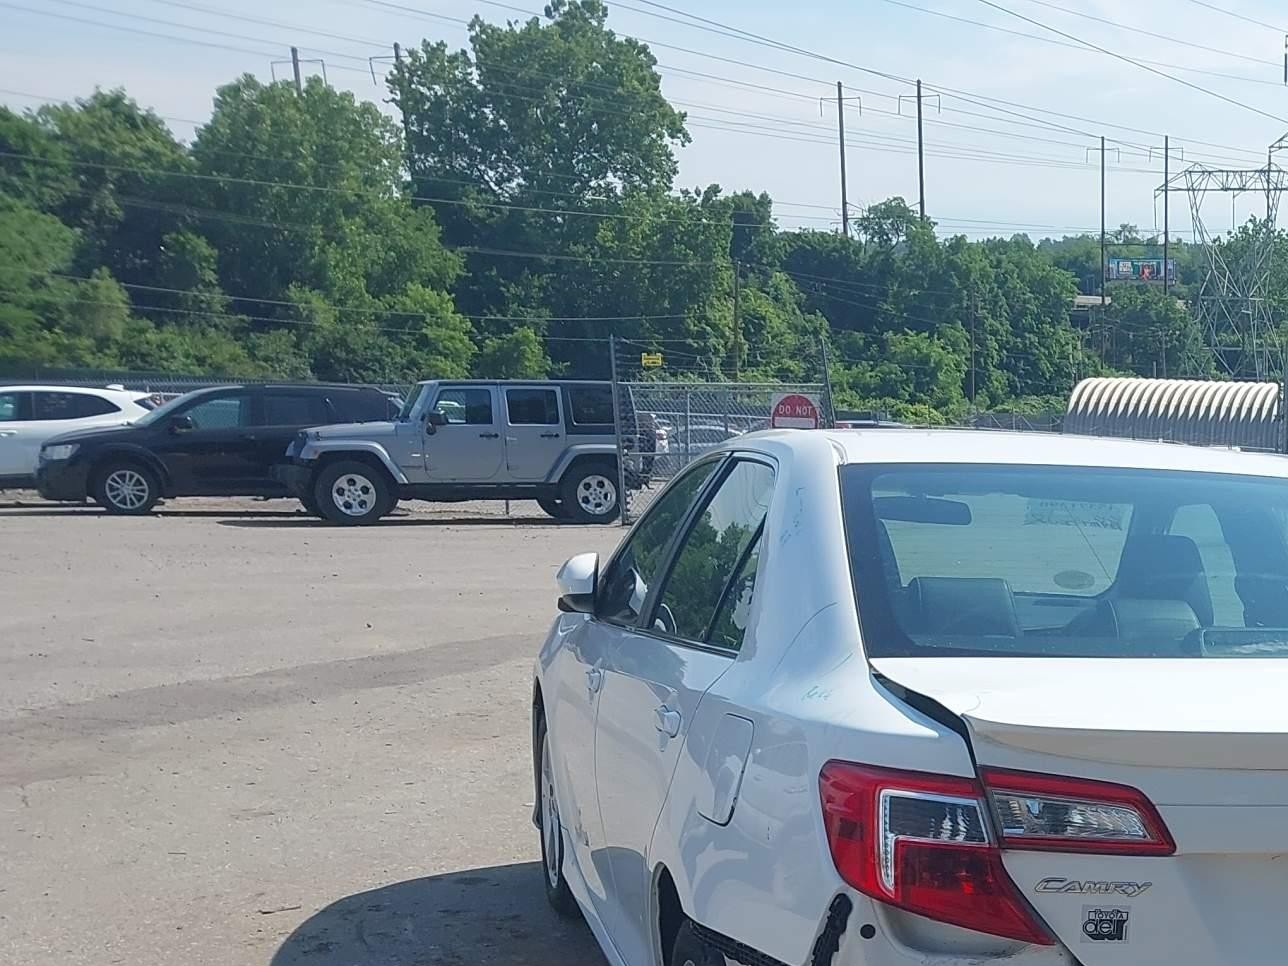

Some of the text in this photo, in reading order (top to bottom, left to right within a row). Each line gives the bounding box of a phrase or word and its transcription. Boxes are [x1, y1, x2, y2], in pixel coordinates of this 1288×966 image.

[778, 405, 813, 416] DO NOT
[1034, 877, 1152, 897] CAMRY
[1094, 909, 1125, 920] TOYOTA
